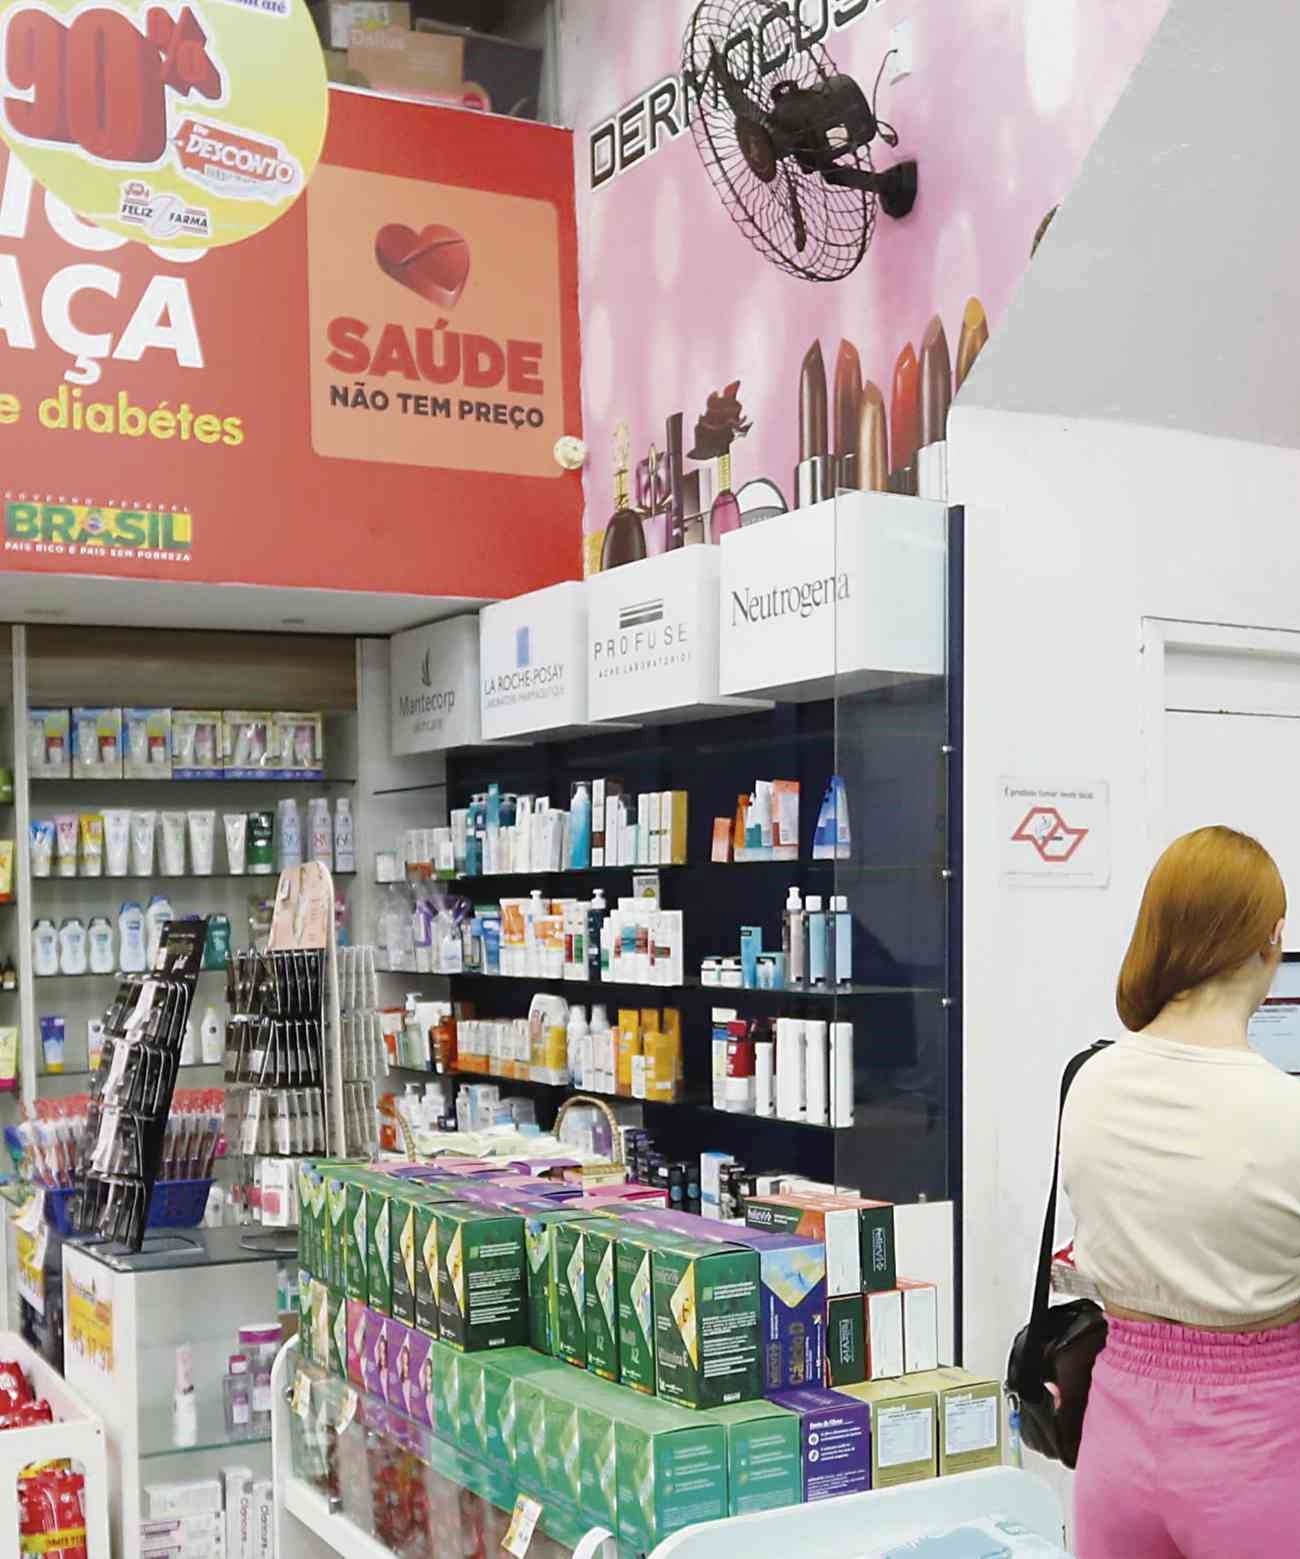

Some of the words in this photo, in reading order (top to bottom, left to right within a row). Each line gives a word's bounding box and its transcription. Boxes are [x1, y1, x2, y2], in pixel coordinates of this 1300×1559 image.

[186, 134, 293, 183] DESCONTO
[121, 203, 153, 218] FELIZ
[169, 212, 208, 228] FARMA
[325, 316, 545, 396] SAÚDE
[39, 385, 246, 447] diabétes
[330, 381, 390, 412] NÃO
[396, 391, 452, 419] TEM
[457, 400, 545, 429] PREÇO
[5, 502, 193, 549] BRASIL
[137, 549, 191, 562] POBREZA
[731, 572, 851, 627] Neutrogena
[593, 622, 690, 661] PROFUSE
[400, 690, 455, 717] Mantecorp
[484, 680, 496, 696] LA
